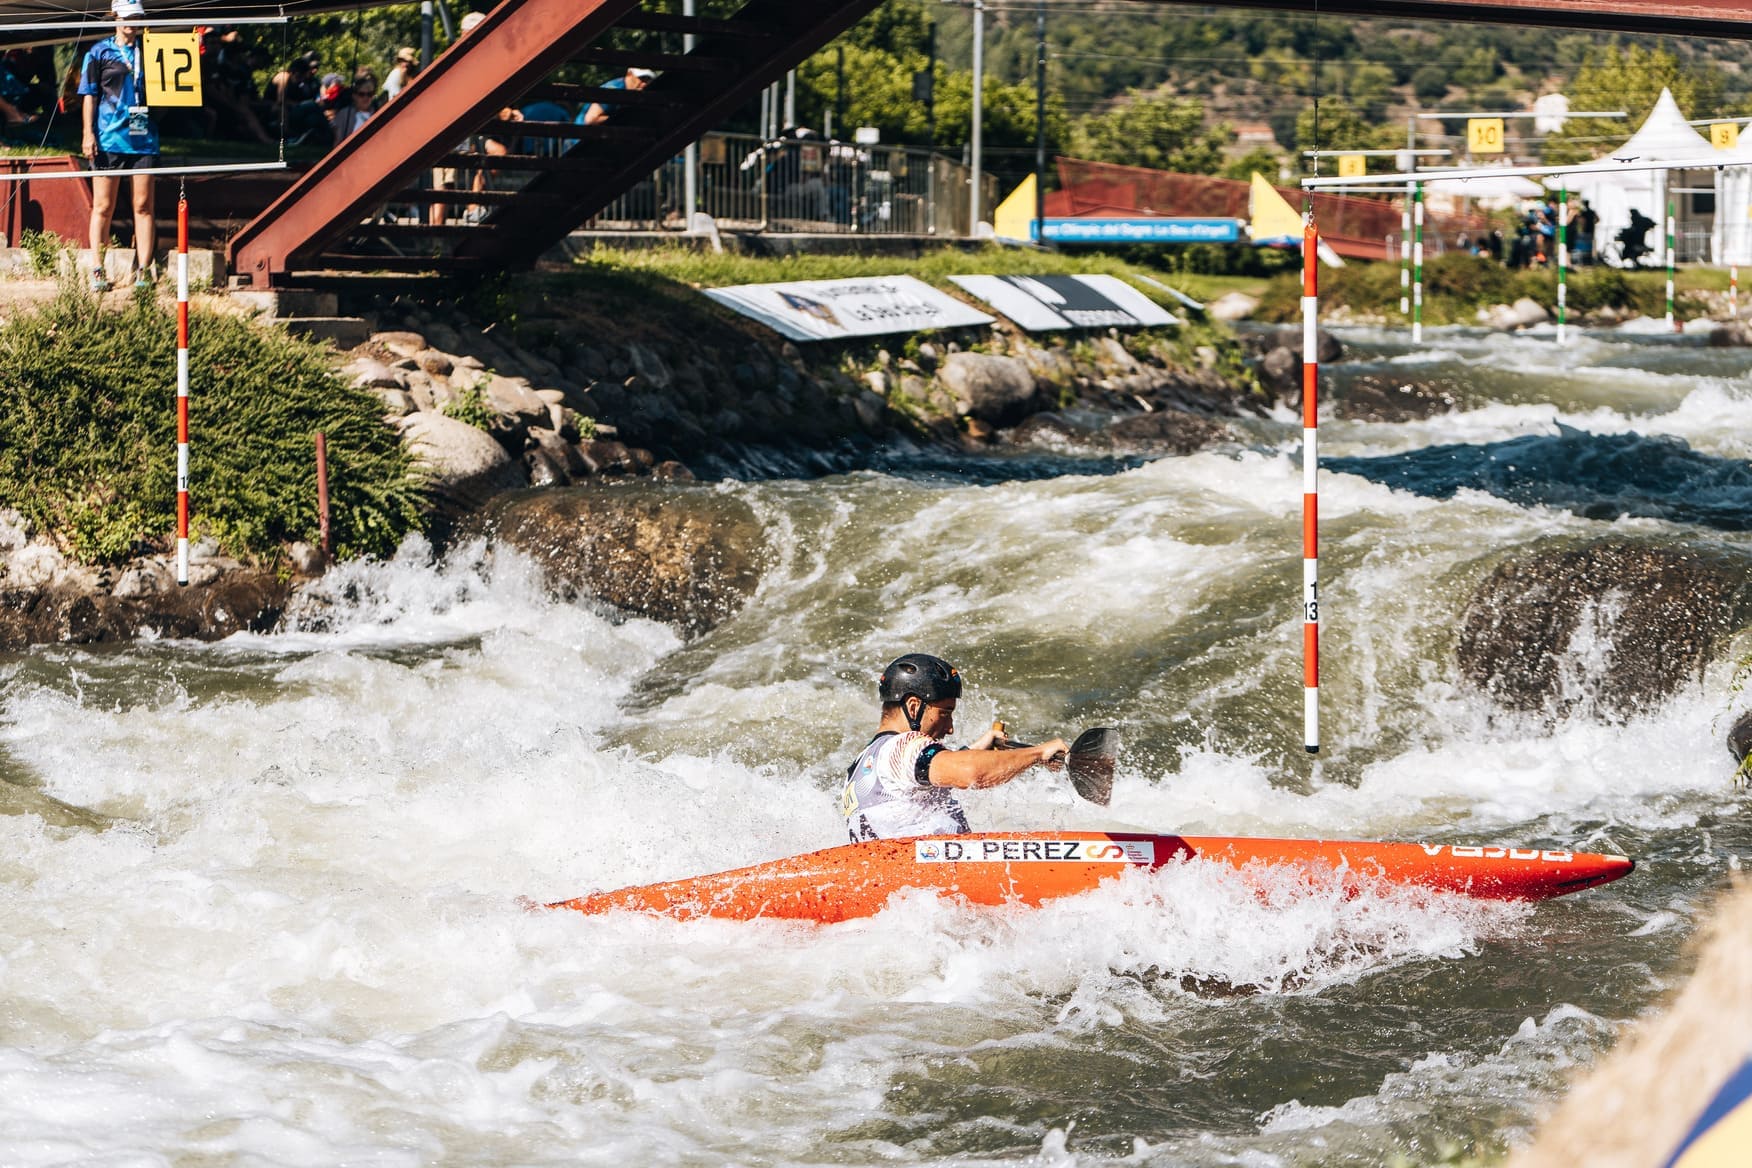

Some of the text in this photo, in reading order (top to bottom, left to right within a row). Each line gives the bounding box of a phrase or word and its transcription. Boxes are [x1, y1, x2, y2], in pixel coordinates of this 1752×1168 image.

[155, 48, 194, 92] 12
[1475, 126, 1497, 145] 10
[1304, 602, 1318, 621] 13
[944, 841, 1082, 861] D. PEREZ
